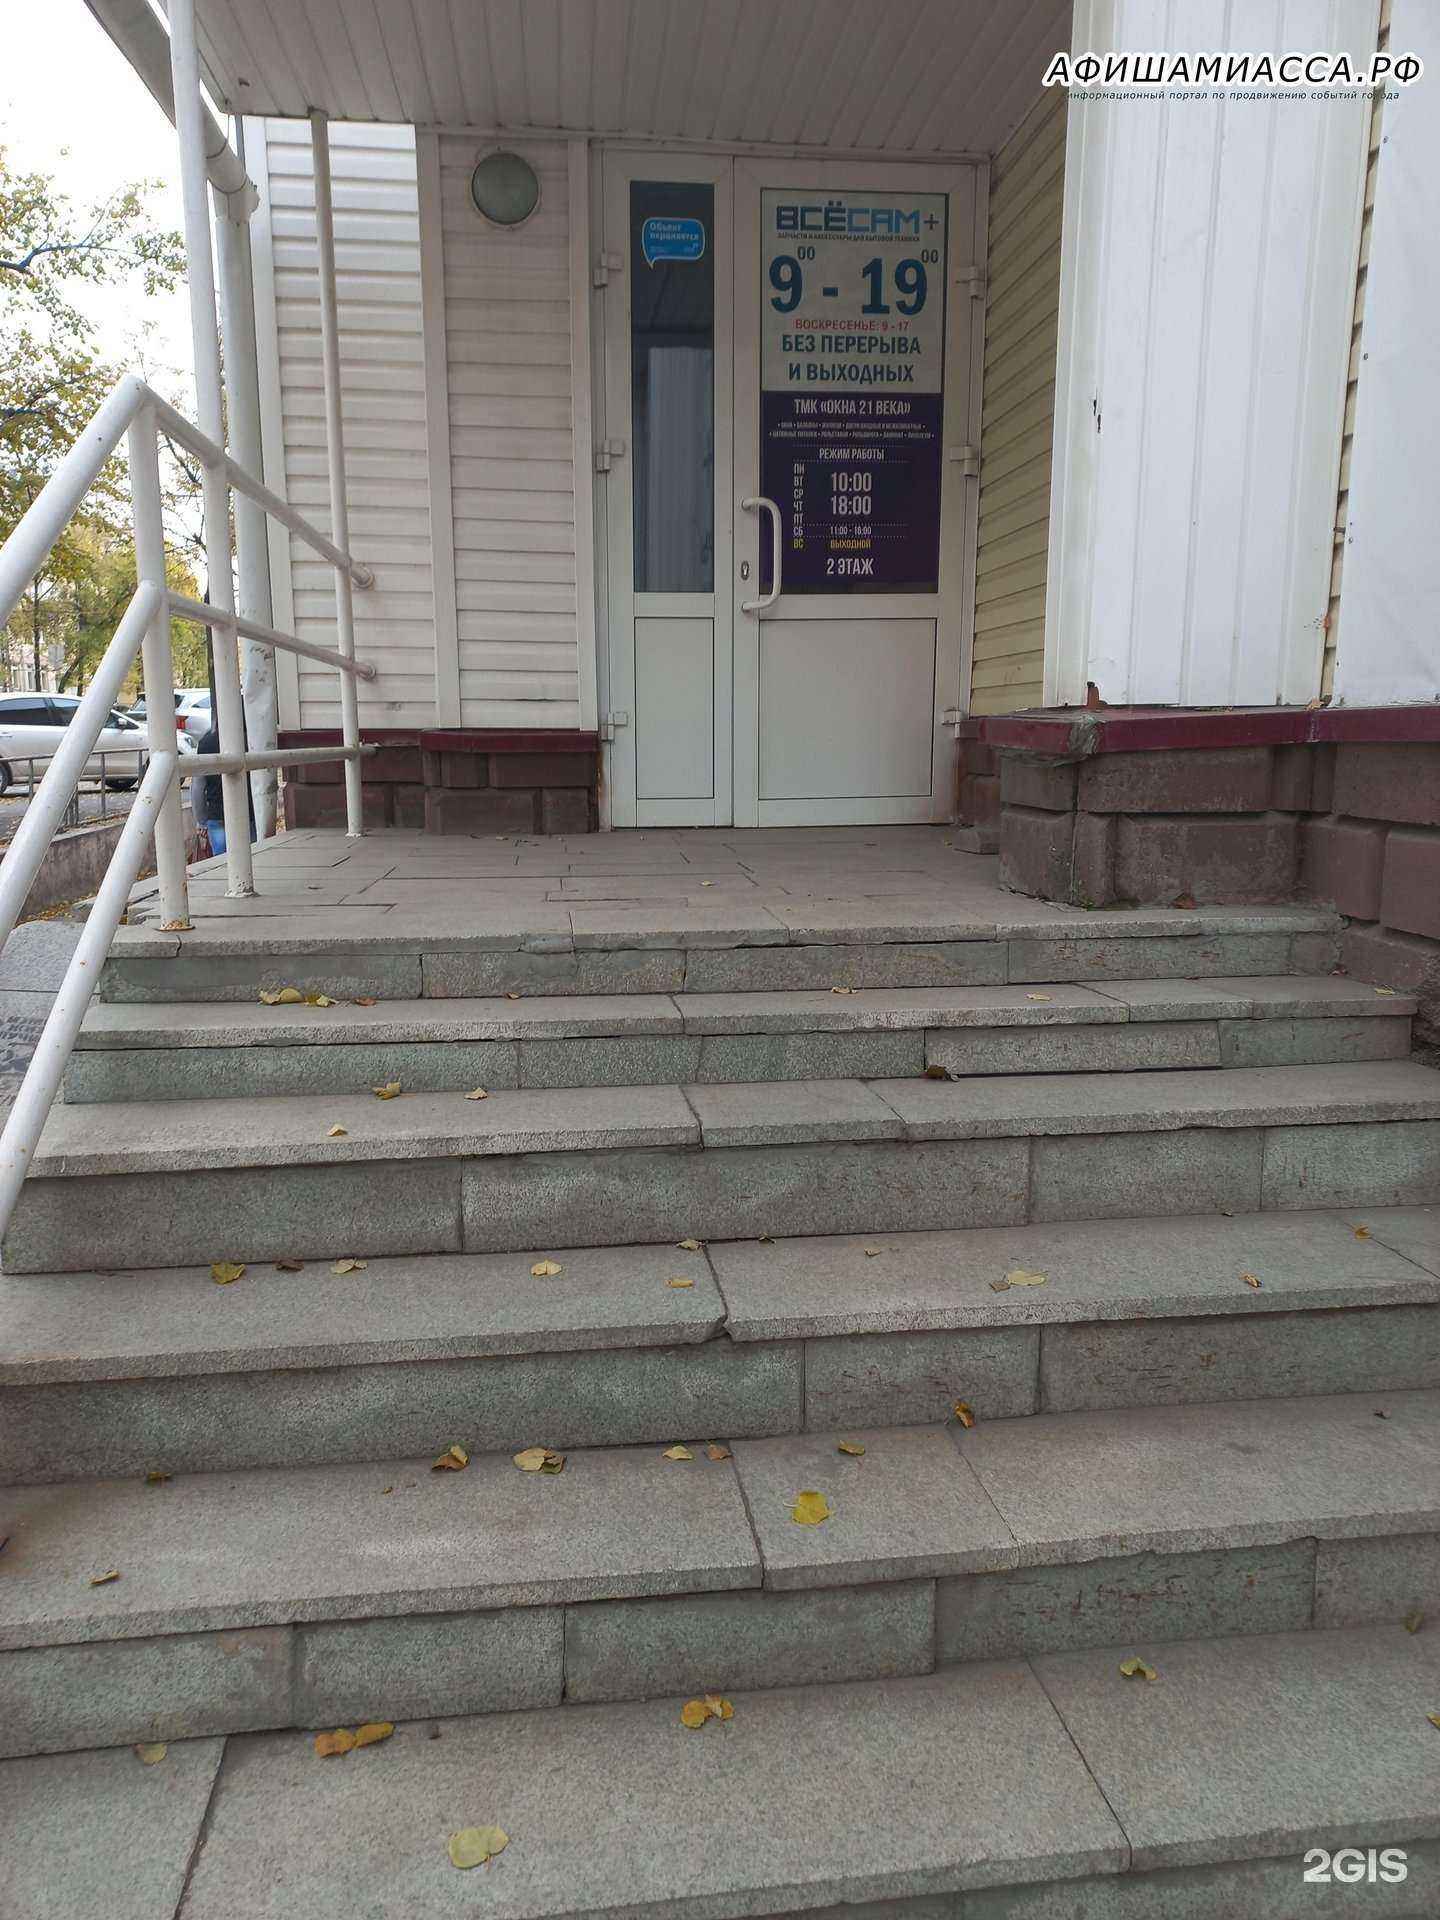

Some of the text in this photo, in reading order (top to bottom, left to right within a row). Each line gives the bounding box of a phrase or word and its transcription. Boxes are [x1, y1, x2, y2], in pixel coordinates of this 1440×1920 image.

[794, 318, 880, 332] ВОСКРЕСЕНЬЕ:
[881, 321, 889, 331] 9
[898, 321, 910, 332] 17
[782, 334, 922, 355] БЕЗ ПЕРЕРЫВА
[789, 362, 915, 385] И ВЫХОДНЫХ
[794, 398, 819, 415] ТМК
[859, 400, 873, 415] 21
[819, 447, 885, 461] РЕЖИМ РАБОТЫ
[793, 463, 805, 475] ПН
[793, 475, 804, 487] ВТ
[831, 471, 873, 493] 10:00
[793, 488, 804, 500] СР
[793, 500, 804, 512] ЧТ
[831, 495, 873, 516] 18:00
[793, 512, 804, 524] ПТ
[793, 526, 804, 537] СБ
[793, 538, 804, 549] ВС
[830, 538, 872, 550] ВЫХОДНОЙ
[826, 558, 875, 575] 2 ЭТАЖ
